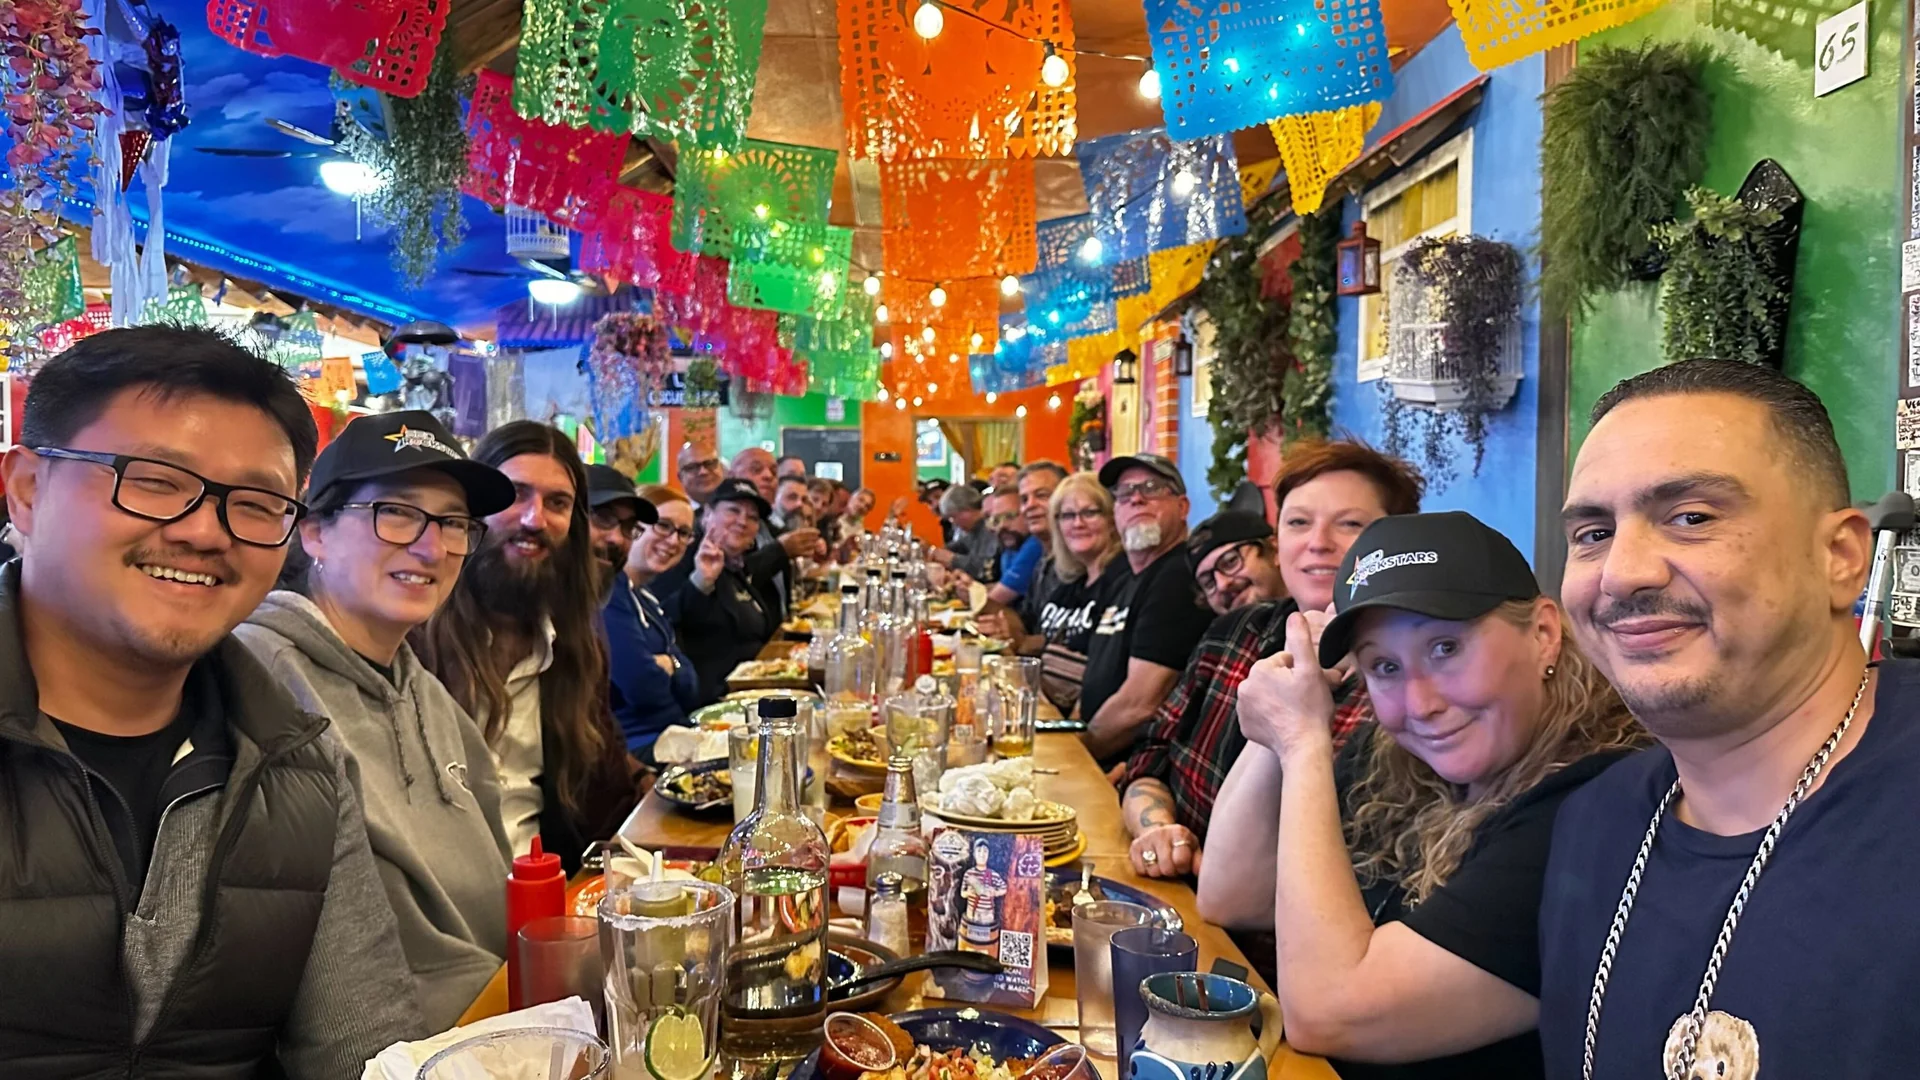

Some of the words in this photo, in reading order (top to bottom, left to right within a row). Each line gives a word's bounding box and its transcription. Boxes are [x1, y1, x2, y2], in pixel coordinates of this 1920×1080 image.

[1819, 22, 1859, 71] 65
[1005, 975, 1030, 984] WATCH
[993, 981, 1006, 990] THE
